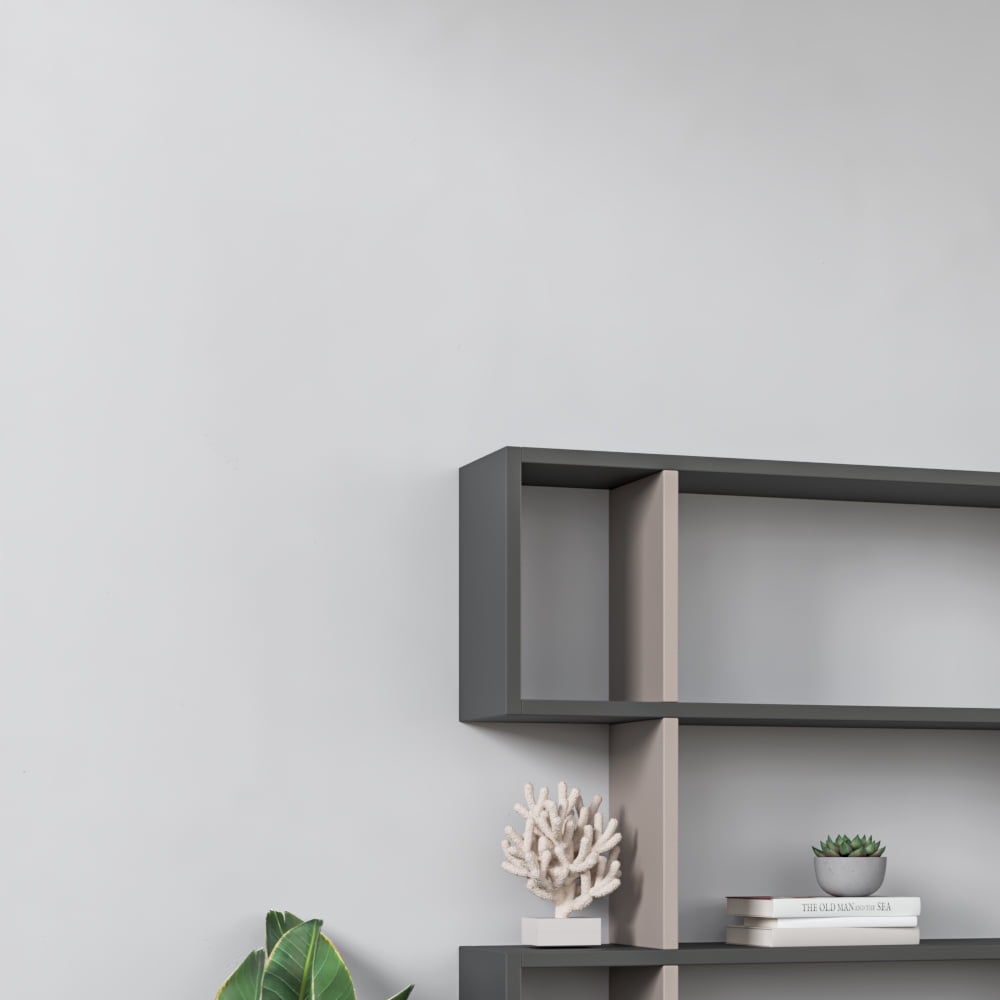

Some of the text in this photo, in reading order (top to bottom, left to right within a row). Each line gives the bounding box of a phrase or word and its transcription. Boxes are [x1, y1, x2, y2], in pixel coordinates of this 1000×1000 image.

[802, 903, 817, 912] THE
[819, 903, 836, 912] OLD
[837, 902, 854, 912] MAN
[876, 902, 892, 912] SEA
